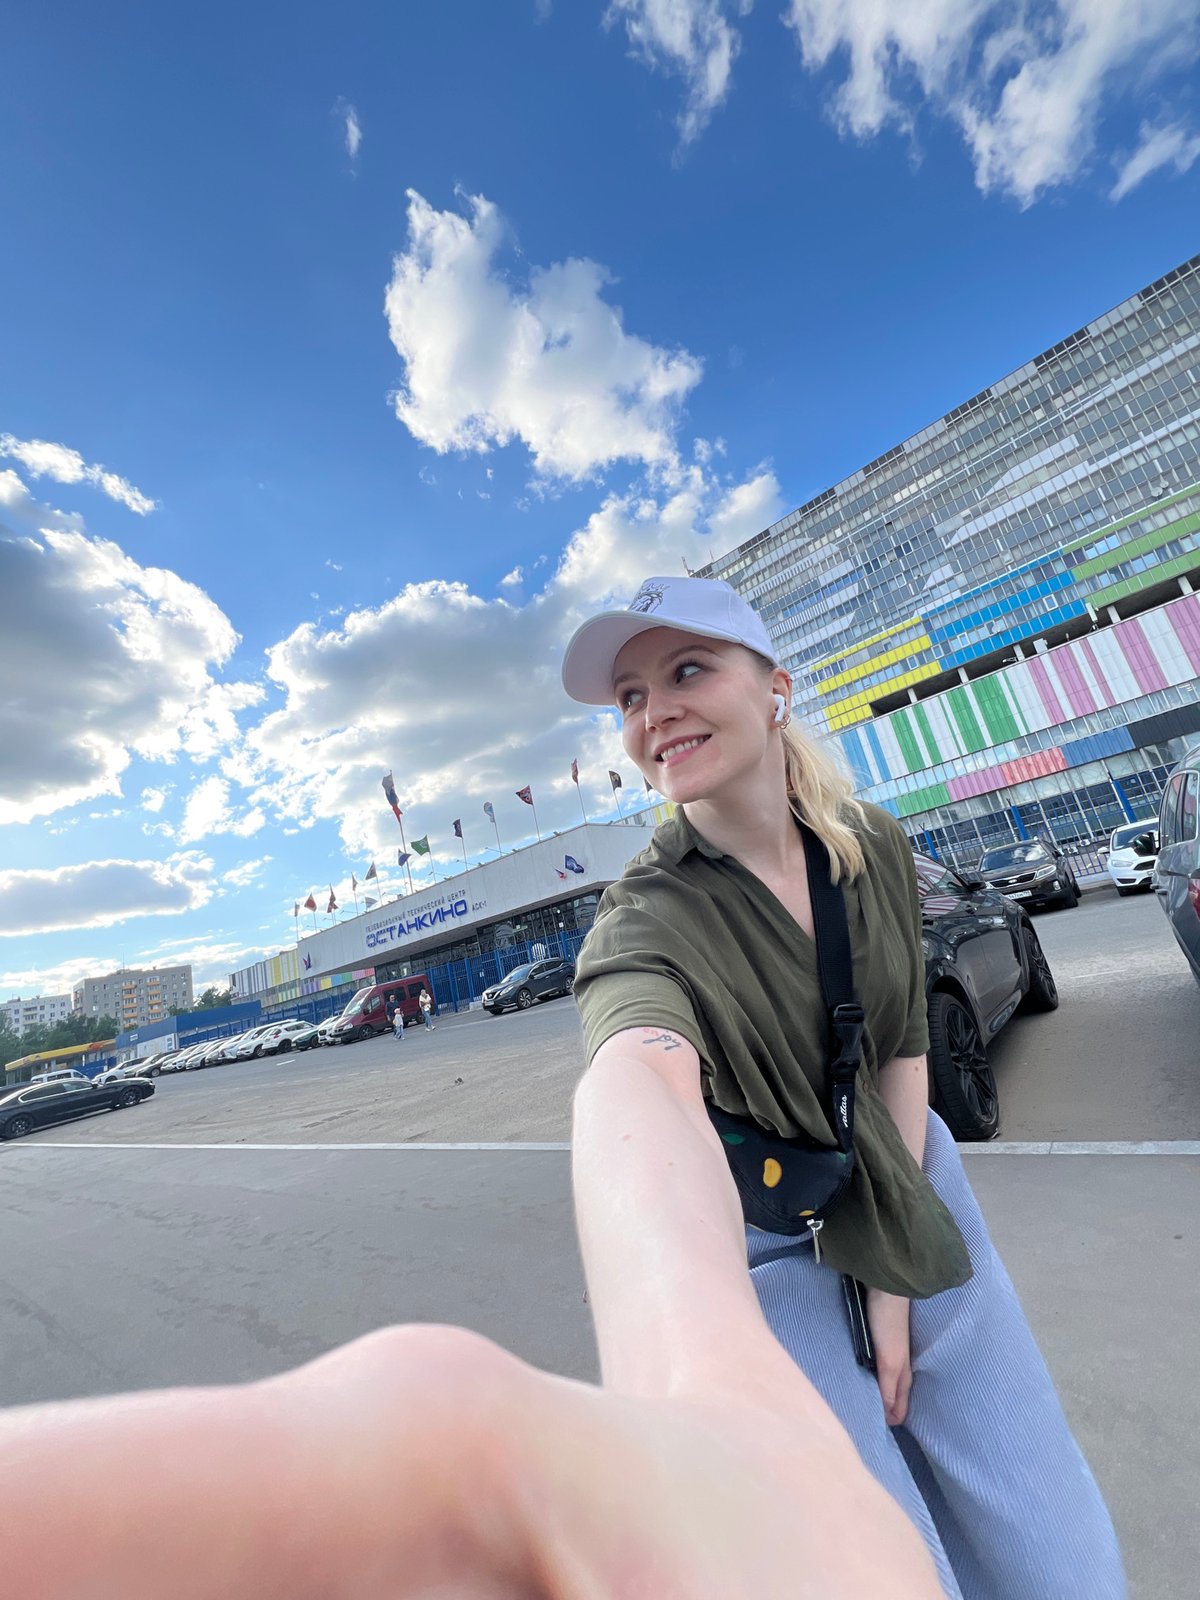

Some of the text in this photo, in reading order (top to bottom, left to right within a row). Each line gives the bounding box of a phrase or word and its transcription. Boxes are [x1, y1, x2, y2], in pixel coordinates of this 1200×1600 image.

[407, 895, 445, 917] ТЕХНИЧЕСКИЙ
[447, 889, 466, 902] ЦЕНТР
[366, 899, 467, 948] ОСТАНКИНО
